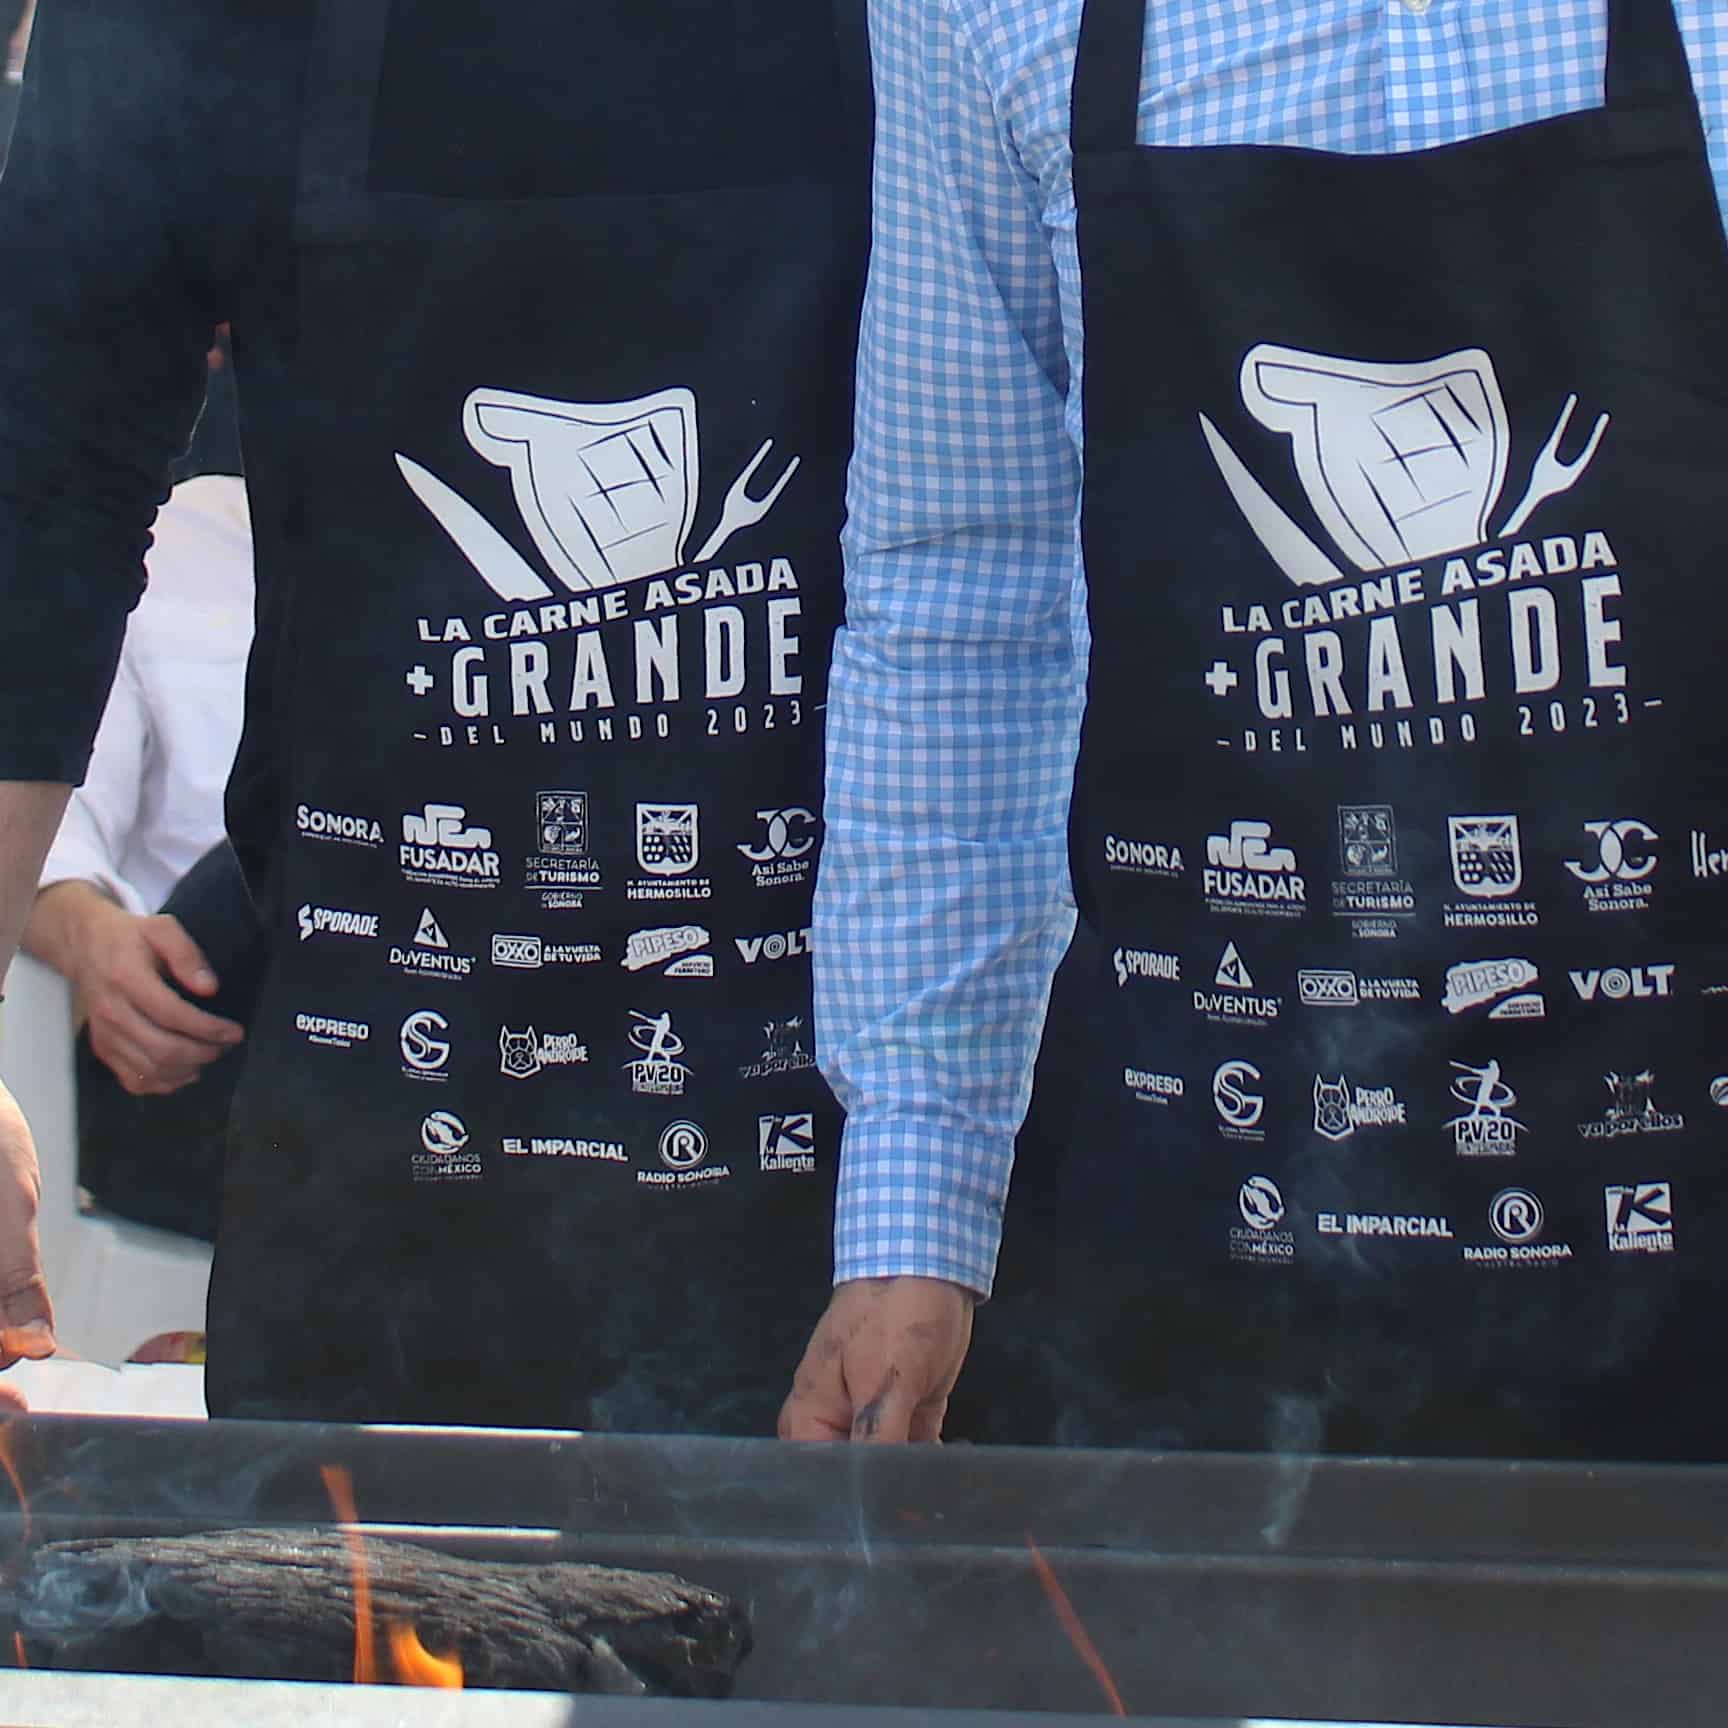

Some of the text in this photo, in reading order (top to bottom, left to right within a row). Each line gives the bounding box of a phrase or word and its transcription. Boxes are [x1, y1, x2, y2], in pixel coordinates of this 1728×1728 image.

[1222, 531, 1617, 632] LA CARNE ASADA
[417, 558, 799, 641] LA CARNE ASADA
[541, 713, 669, 743] MUNDO
[1342, 714, 1475, 748] MUNDO
[296, 805, 383, 841] SONORA
[399, 845, 499, 876] FUSADAR
[1105, 836, 1184, 871] SONORA
[539, 870, 600, 883] TURISMO
[1203, 870, 1305, 900] FUSADAR
[627, 887, 711, 900] HERMOSILLO
[1613, 883, 1652, 897] Sabe
[1346, 896, 1414, 909] TURISMO
[1444, 911, 1538, 927] HERMOSILLO
[495, 940, 538, 961] OXXO
[1125, 949, 1180, 981] SPORADE
[1303, 977, 1353, 997] OXXO
[1452, 961, 1524, 996] PIPESO
[1568, 964, 1675, 1000] VOLT
[1356, 1087, 1394, 1105] PERRO
[1459, 1121, 1512, 1140] PV20
[503, 1139, 628, 1161] EL IMPARCIAL
[637, 1165, 730, 1183] RADIO SONORA
[1318, 1214, 1454, 1237] EL IMPARCIAL
[1464, 1244, 1572, 1260] RADIO SONORA
